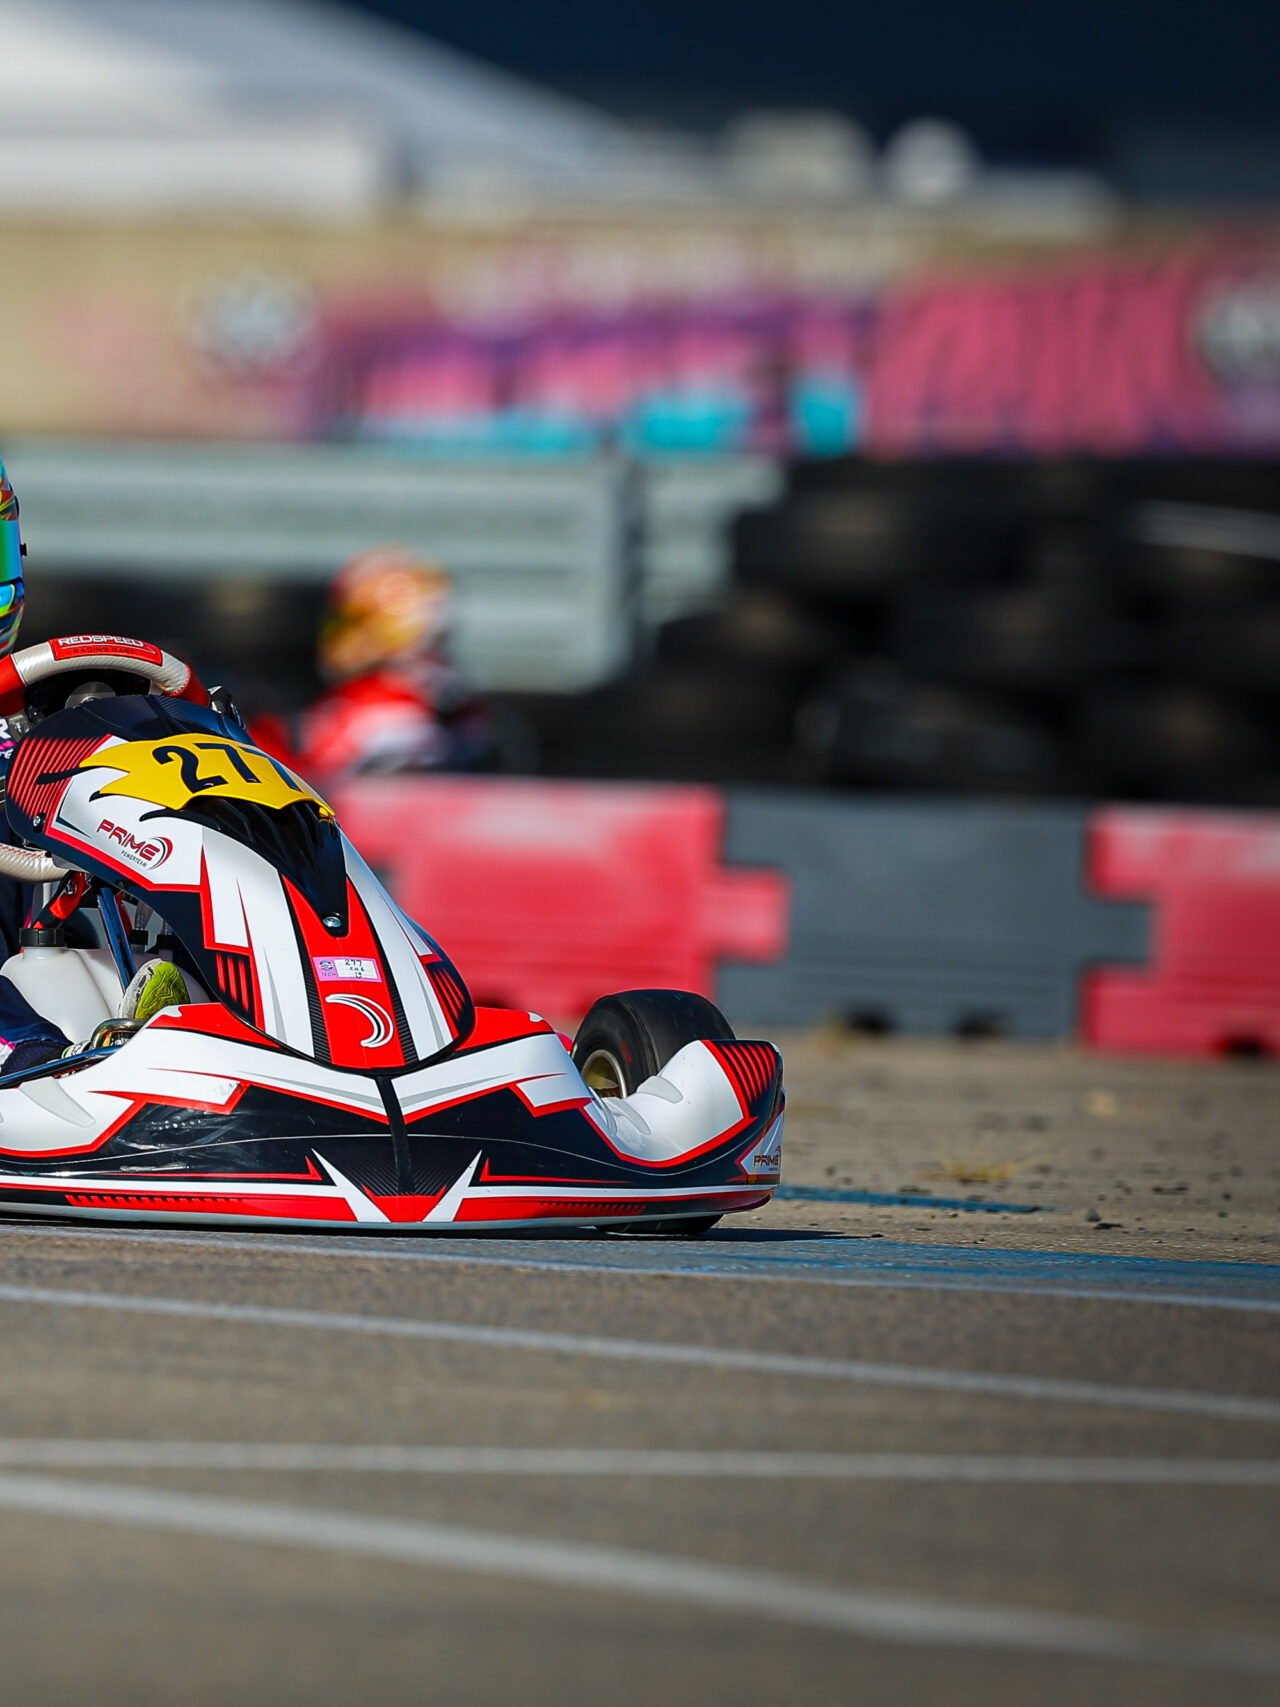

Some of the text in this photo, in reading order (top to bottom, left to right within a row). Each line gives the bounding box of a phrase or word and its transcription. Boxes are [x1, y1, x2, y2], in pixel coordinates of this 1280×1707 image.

[57, 635, 144, 647] REDSPEED
[152, 743, 304, 794] 277
[96, 818, 160, 862] PRIME
